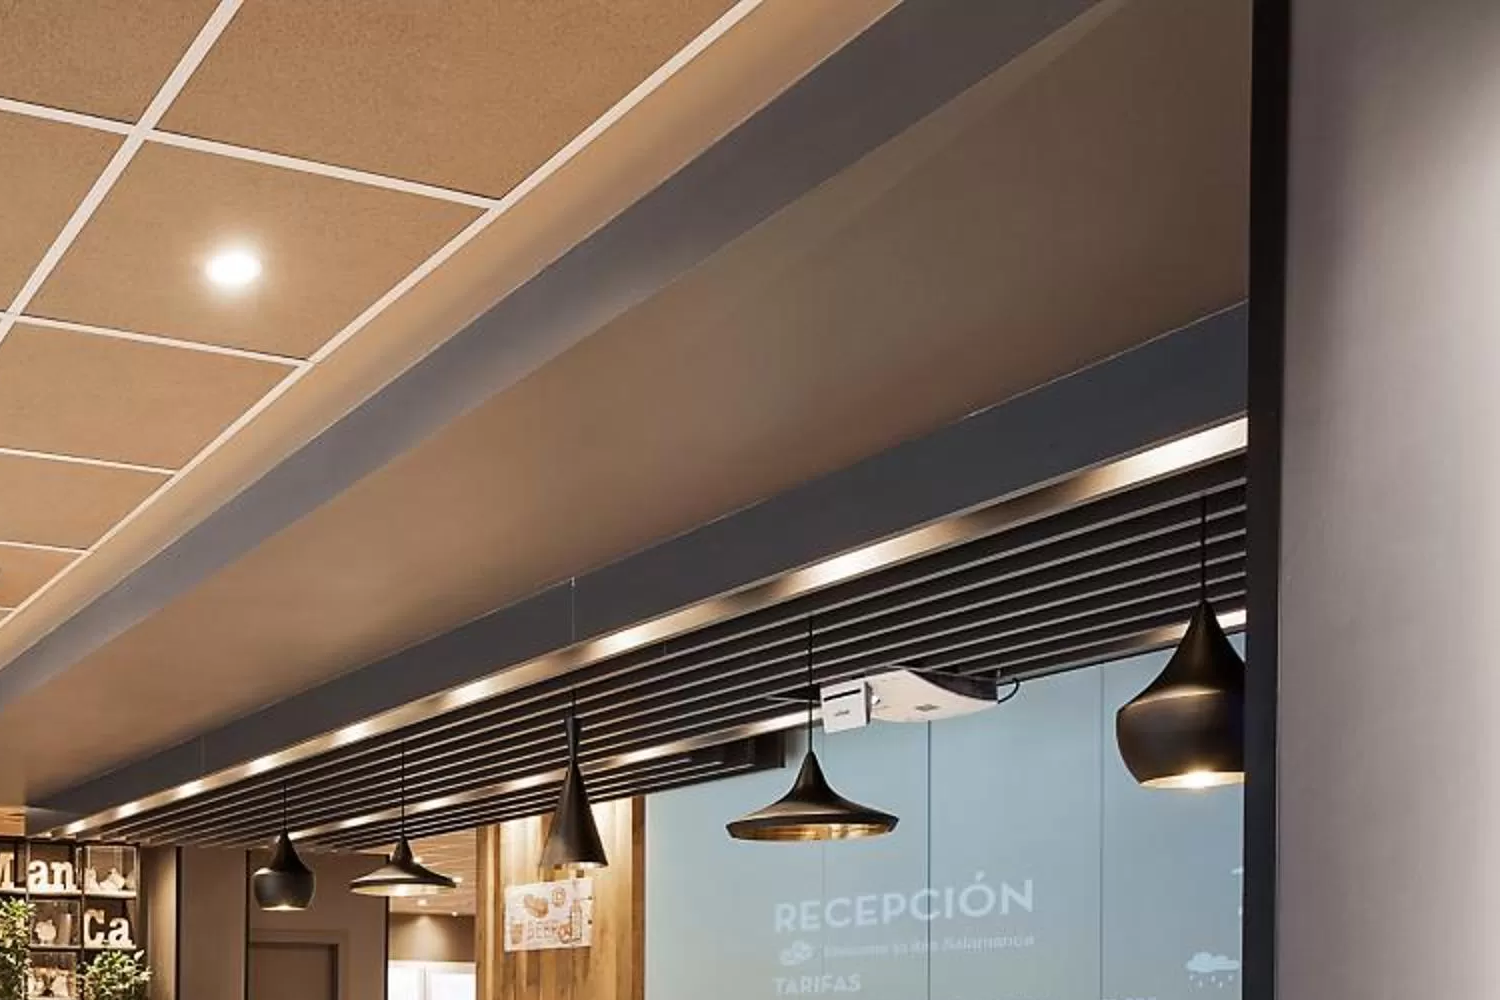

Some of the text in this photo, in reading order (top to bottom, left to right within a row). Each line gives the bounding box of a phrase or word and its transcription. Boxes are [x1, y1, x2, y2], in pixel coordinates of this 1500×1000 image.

[774, 871, 1033, 933] RECEPCIÓN
[84, 909, 133, 947] Ca
[773, 974, 861, 995] TARIFAS
